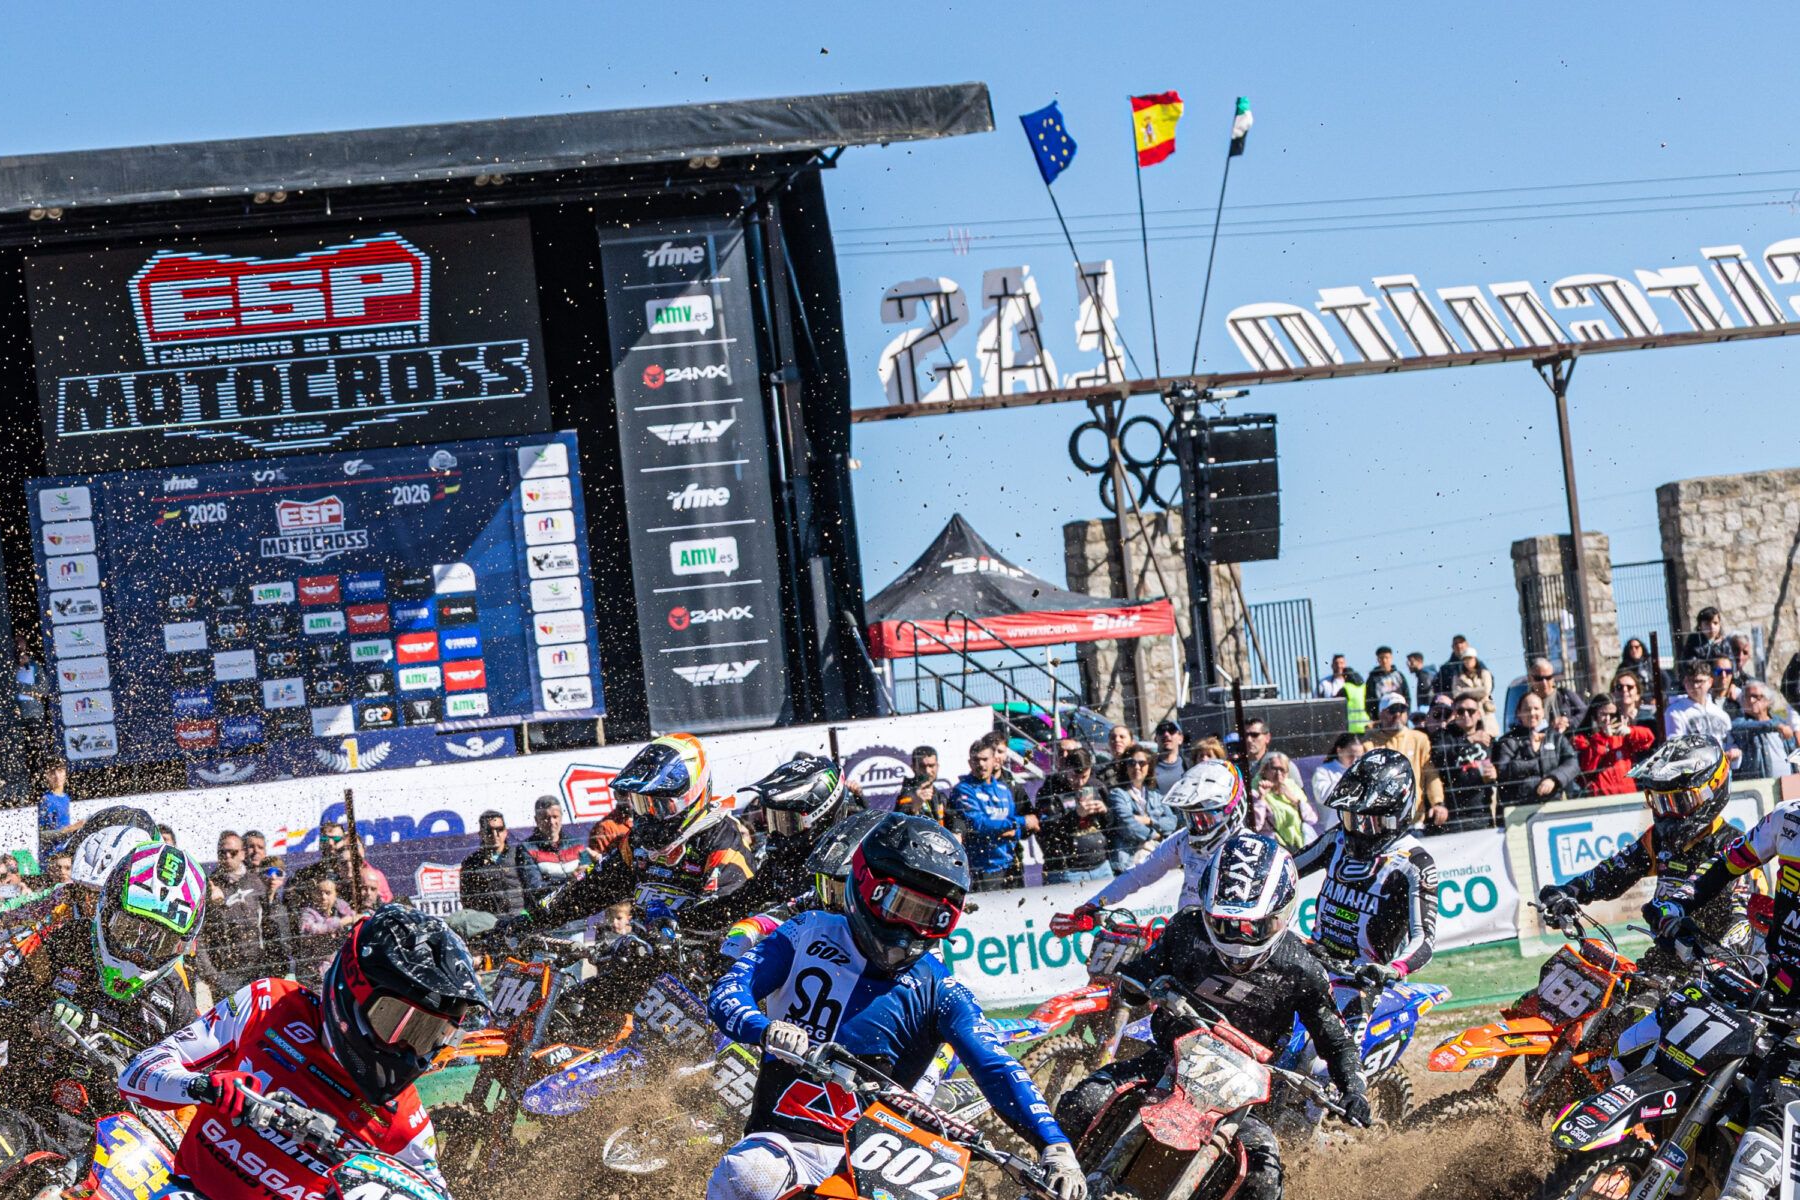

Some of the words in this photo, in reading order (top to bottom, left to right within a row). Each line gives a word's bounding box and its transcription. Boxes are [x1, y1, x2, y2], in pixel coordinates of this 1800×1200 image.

[646, 241, 705, 268] rfme
[149, 262, 417, 333] ESP
[665, 364, 728, 383] 24MX
[58, 339, 534, 437] MOTOCROSS
[392, 484, 431, 505] 2026
[670, 483, 731, 511] rfme
[188, 503, 228, 524] 2026
[280, 504, 339, 526] ESP
[263, 532, 368, 556] MOTOCROSS
[690, 605, 754, 624] 24MX
[341, 738, 358, 769] 1
[860, 762, 906, 783] rfme
[1437, 864, 1491, 880] remadura
[1323, 879, 1379, 915] YAMAHA
[807, 940, 851, 968] 602
[1665, 1006, 1734, 1060] 11
[850, 1133, 964, 1200] 602
